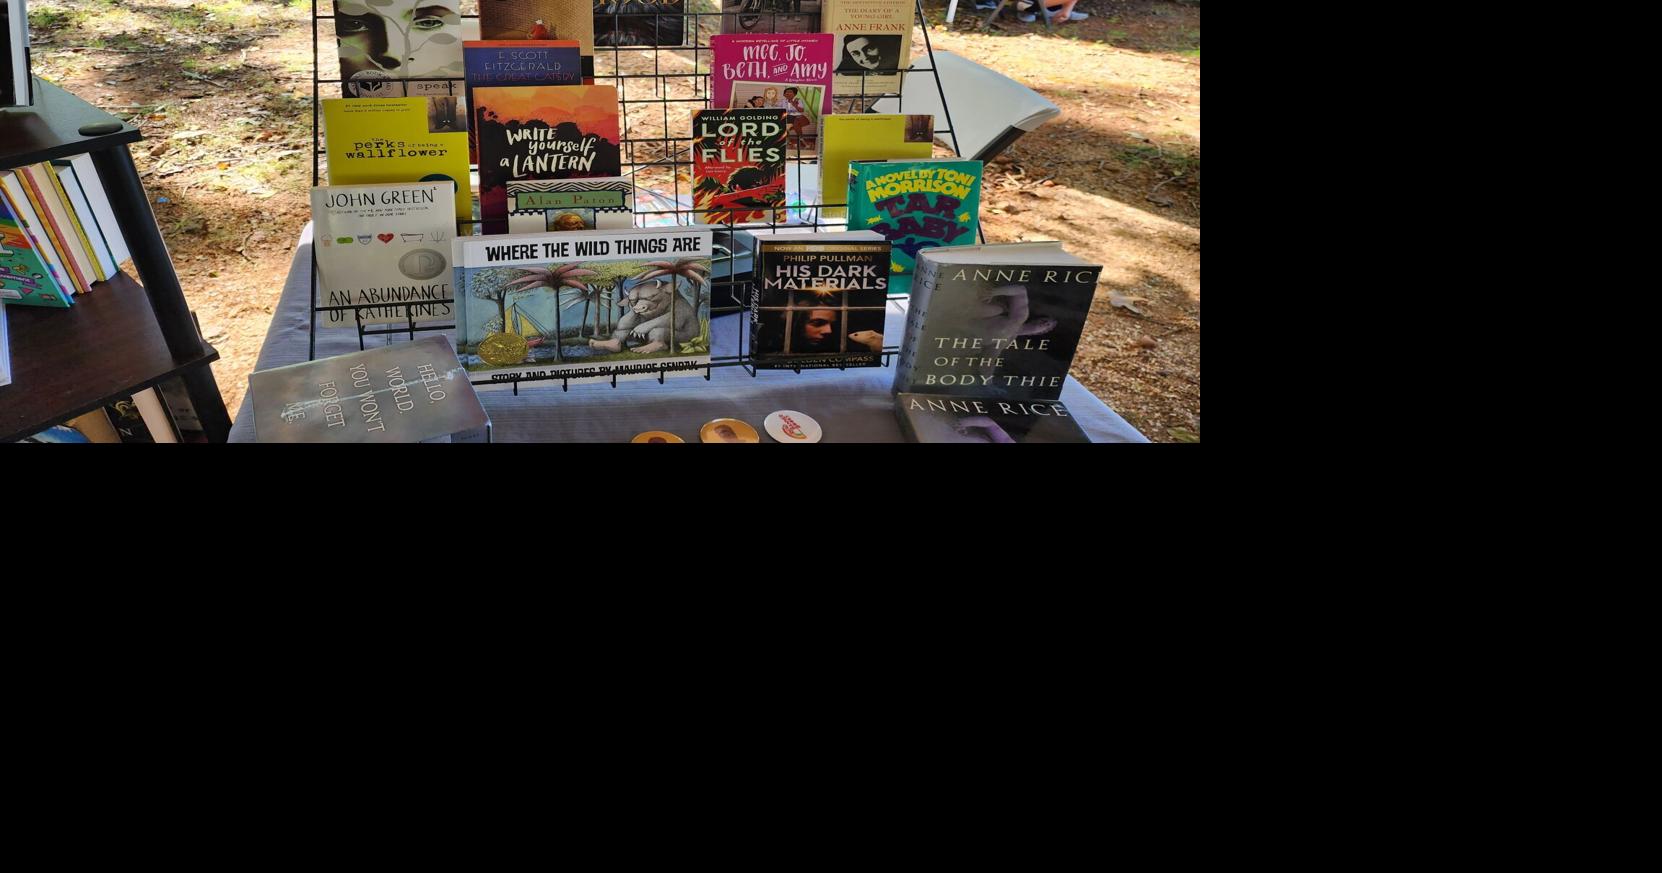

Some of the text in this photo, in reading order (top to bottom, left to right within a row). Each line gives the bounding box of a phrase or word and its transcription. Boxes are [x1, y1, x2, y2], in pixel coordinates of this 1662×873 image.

[836, 23, 905, 31] ANNE FRANK
[511, 51, 549, 60] SCOTT
[484, 62, 562, 71] FITZGERALD
[773, 63, 788, 75] AND
[472, 72, 576, 81] THE GREAT GATSBY
[506, 126, 558, 146] WRITE
[701, 122, 780, 138] LORD
[354, 139, 406, 151] perks
[528, 137, 597, 156] yourself
[720, 138, 762, 148] of the
[345, 148, 448, 159] wallflower
[702, 147, 780, 163] FLIES
[500, 151, 597, 178] a LANTERN
[865, 179, 874, 191] A
[874, 169, 917, 186] NOVEL
[917, 169, 933, 179] BY
[933, 168, 976, 187] TONI
[867, 179, 972, 203] MORRISON
[325, 192, 376, 209] JOHN
[526, 194, 615, 206] Alan Paton
[874, 193, 961, 219] TAR
[870, 216, 970, 243] BABY
[485, 236, 701, 262] WHERE THE WILD THINGS ARE
[775, 265, 877, 278] HIS DARK
[952, 269, 1032, 283] ANNE
[764, 277, 887, 290] MATERIALS
[329, 283, 449, 306] AN ABUNDANCE
[329, 308, 346, 322] OF
[935, 337, 1050, 350] THE TALE
[934, 356, 1005, 367] OF THE
[350, 363, 370, 388] YOU
[926, 374, 994, 386] BODY
[417, 363, 446, 404] HELLO,
[319, 381, 345, 428] FORGET
[909, 398, 1068, 417] ANNE RICE
